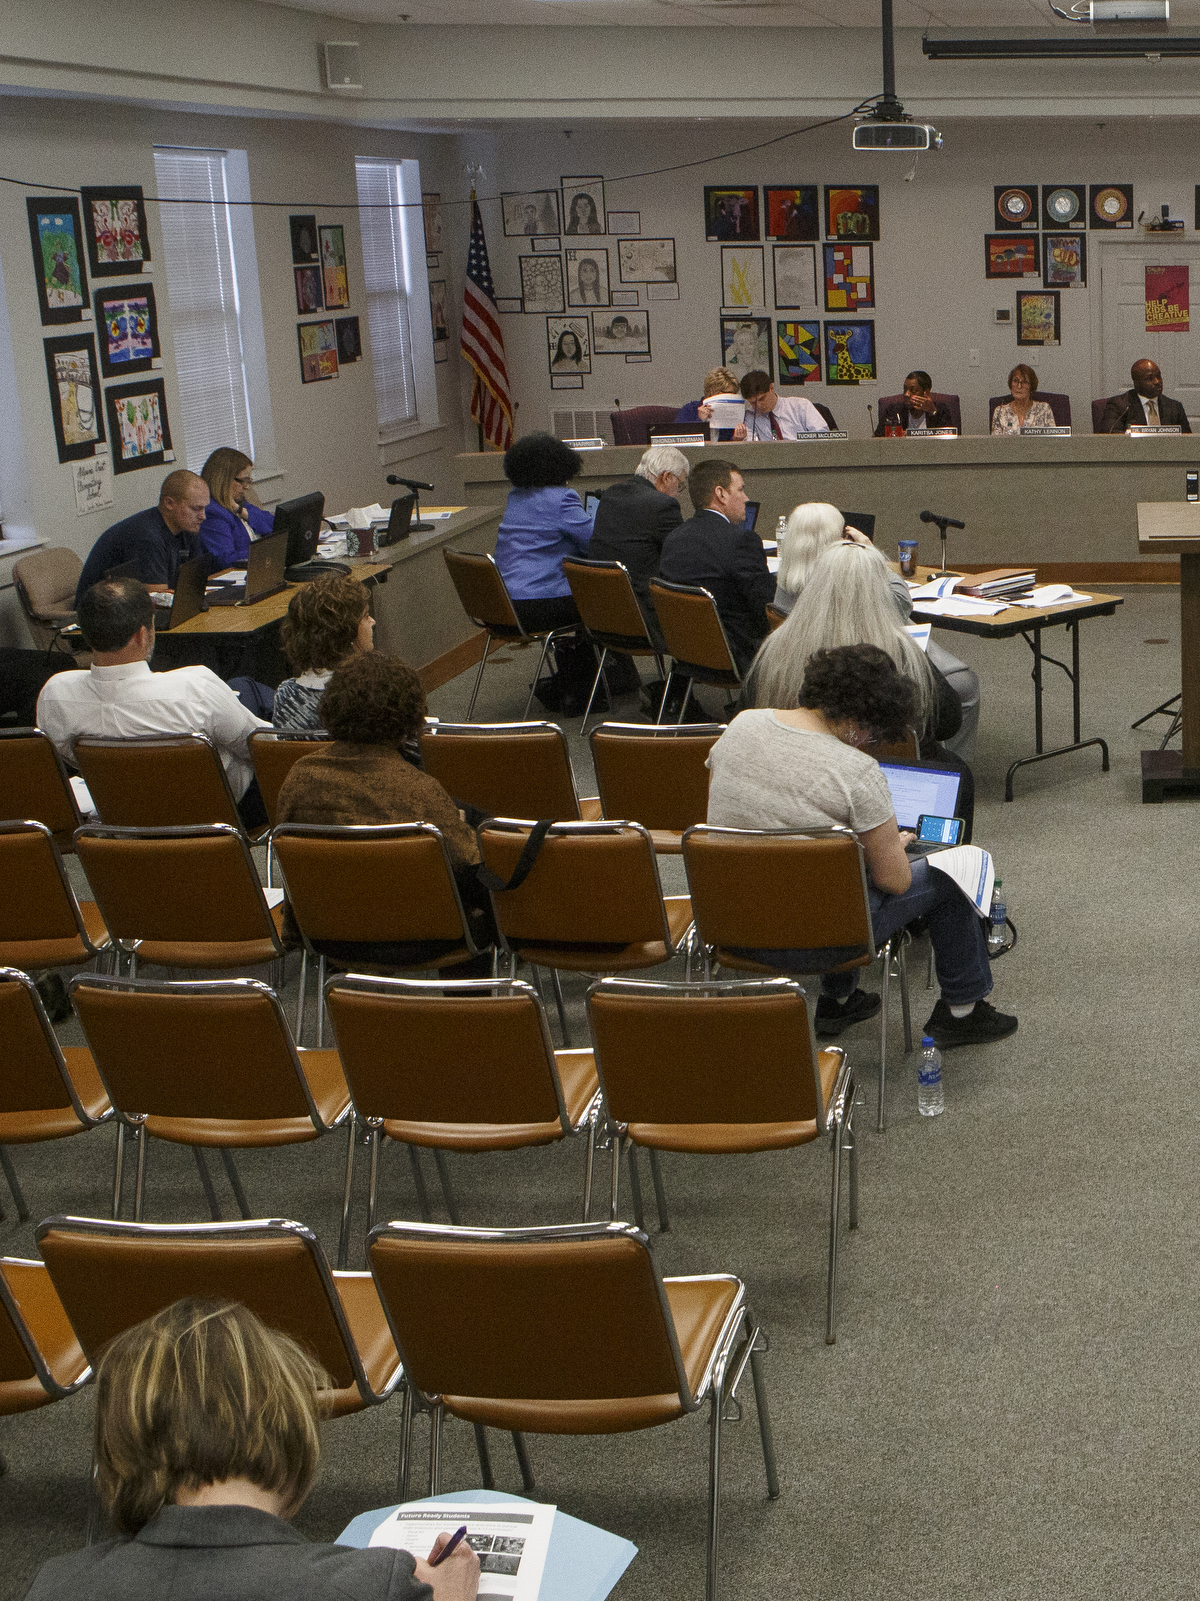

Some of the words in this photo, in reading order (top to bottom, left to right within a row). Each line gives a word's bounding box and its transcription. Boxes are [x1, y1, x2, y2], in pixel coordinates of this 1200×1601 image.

[1146, 299, 1167, 308] HELP
[1146, 305, 1166, 314] KIDS
[1168, 304, 1179, 312] BE
[1146, 309, 1188, 320] CREATIVE
